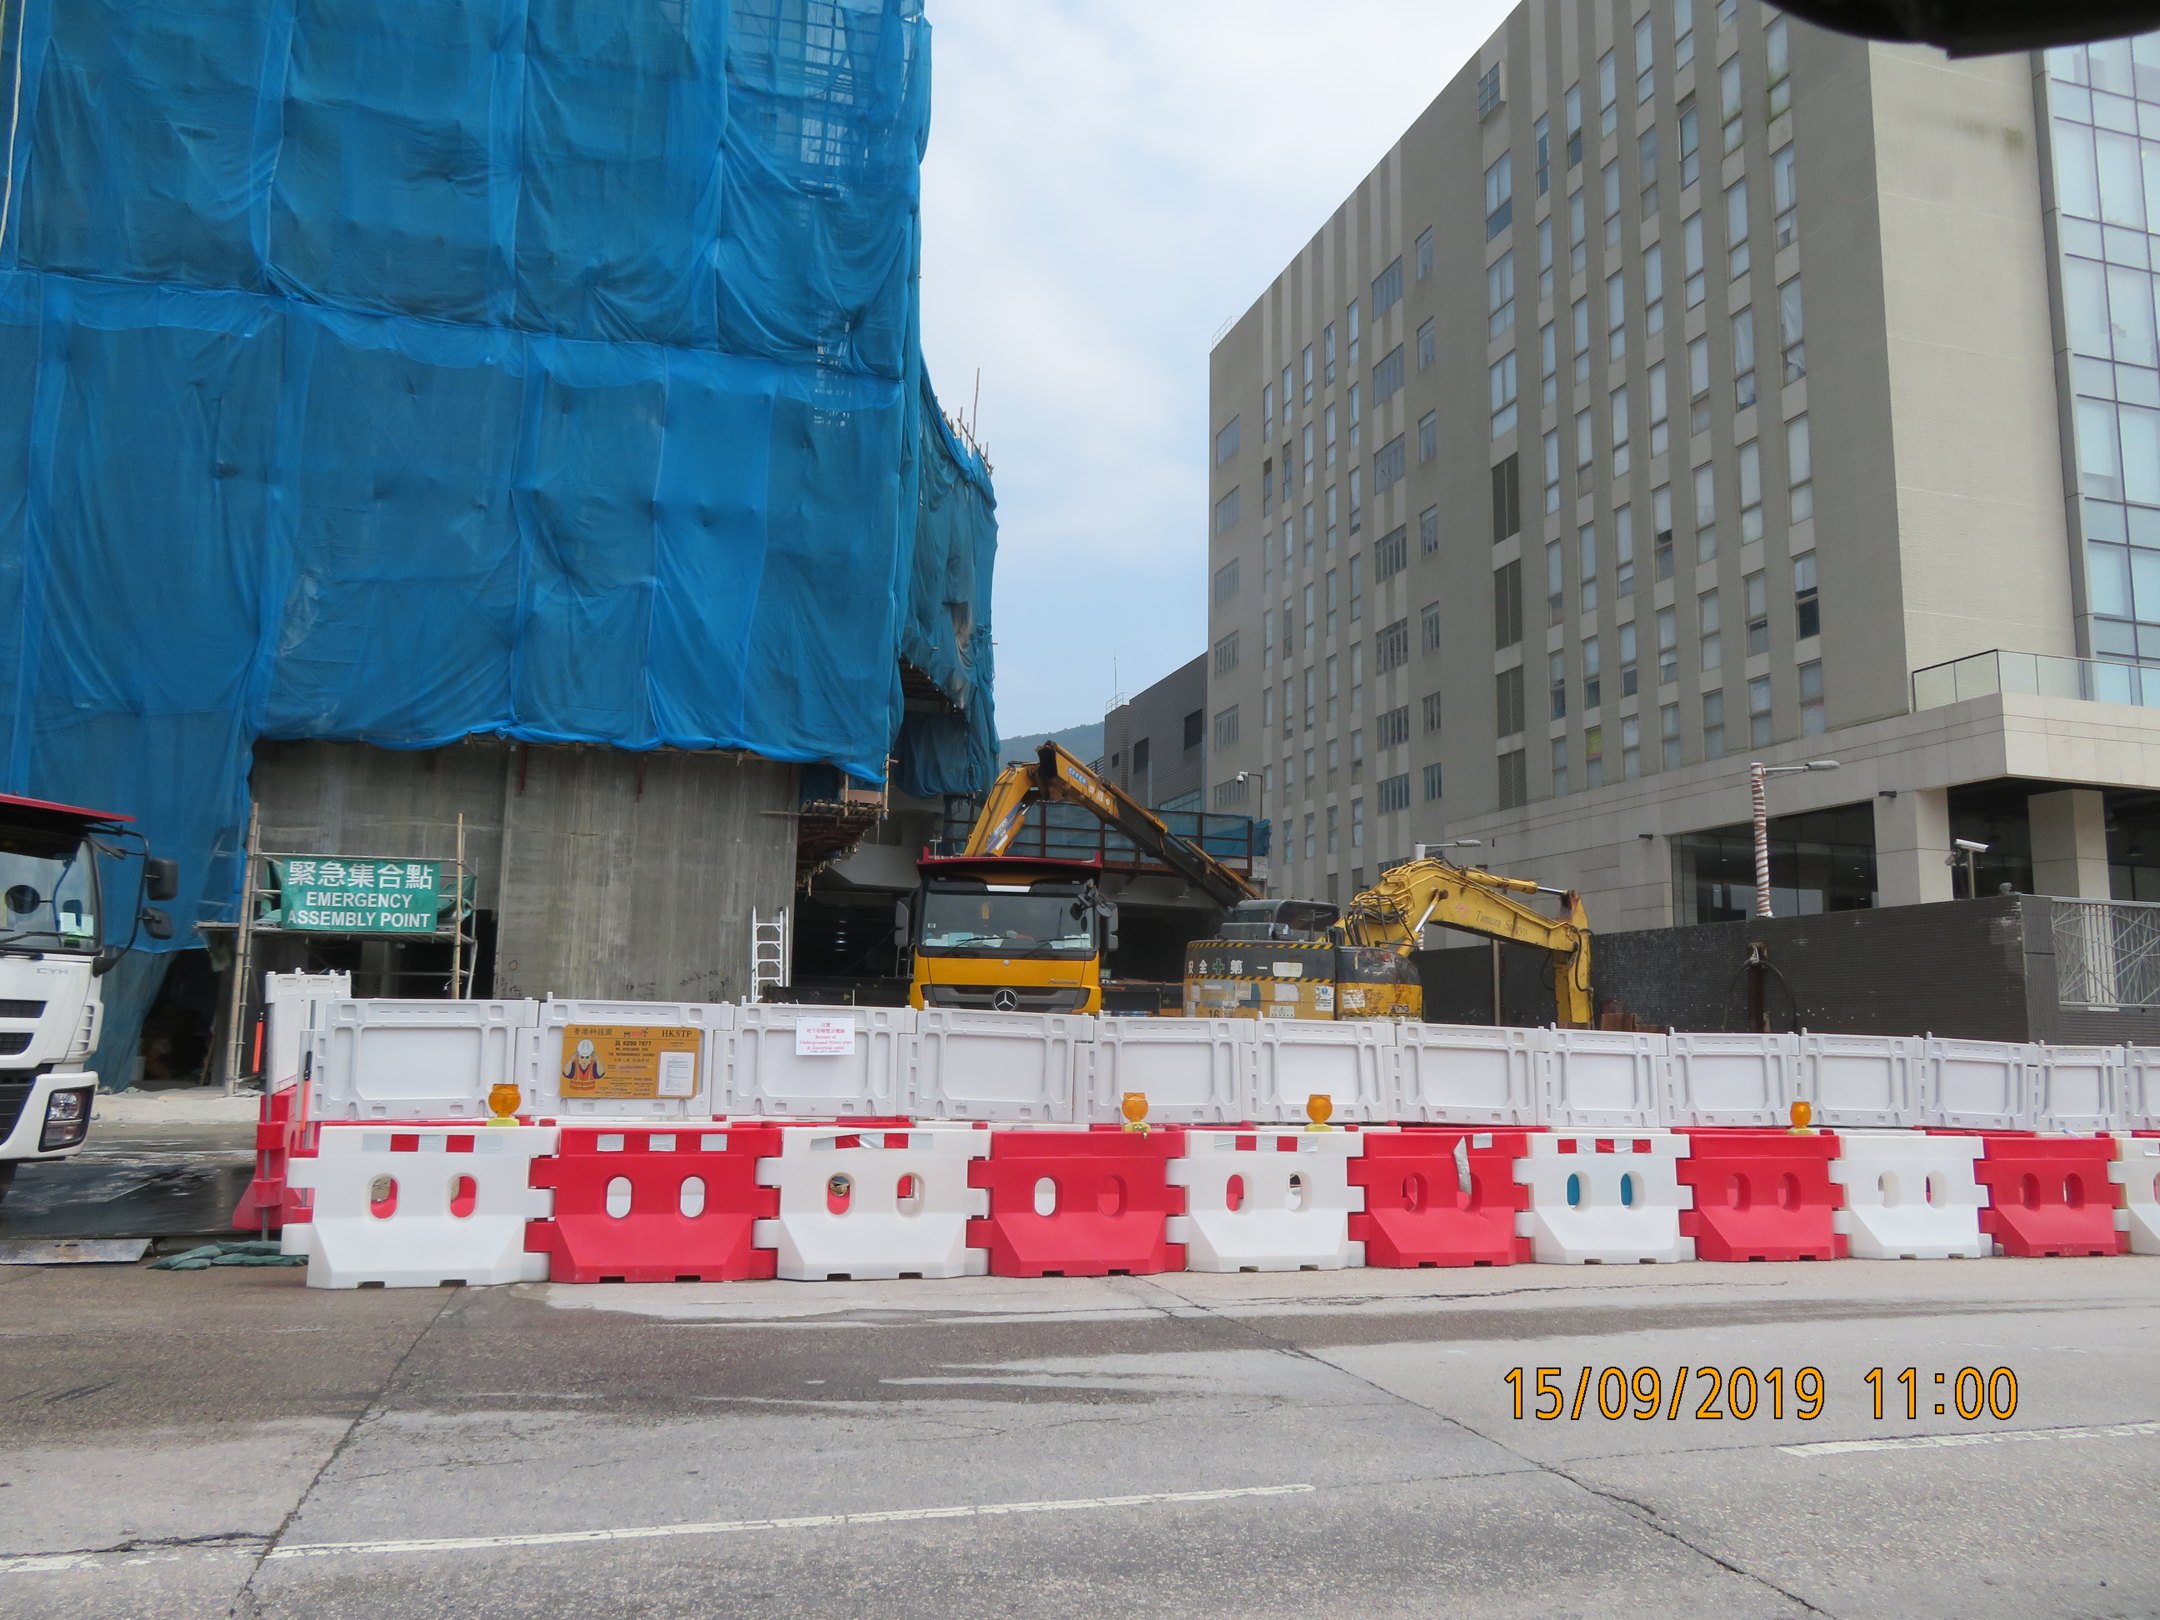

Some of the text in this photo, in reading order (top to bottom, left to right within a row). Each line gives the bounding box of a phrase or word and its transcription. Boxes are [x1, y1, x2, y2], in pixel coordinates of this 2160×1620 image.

[288, 861, 434, 890] 緊急集合點
[306, 891, 413, 909] EMERGENCY
[287, 910, 431, 928] ASSEMBLY POINT
[661, 1029, 693, 1038] HKSTP
